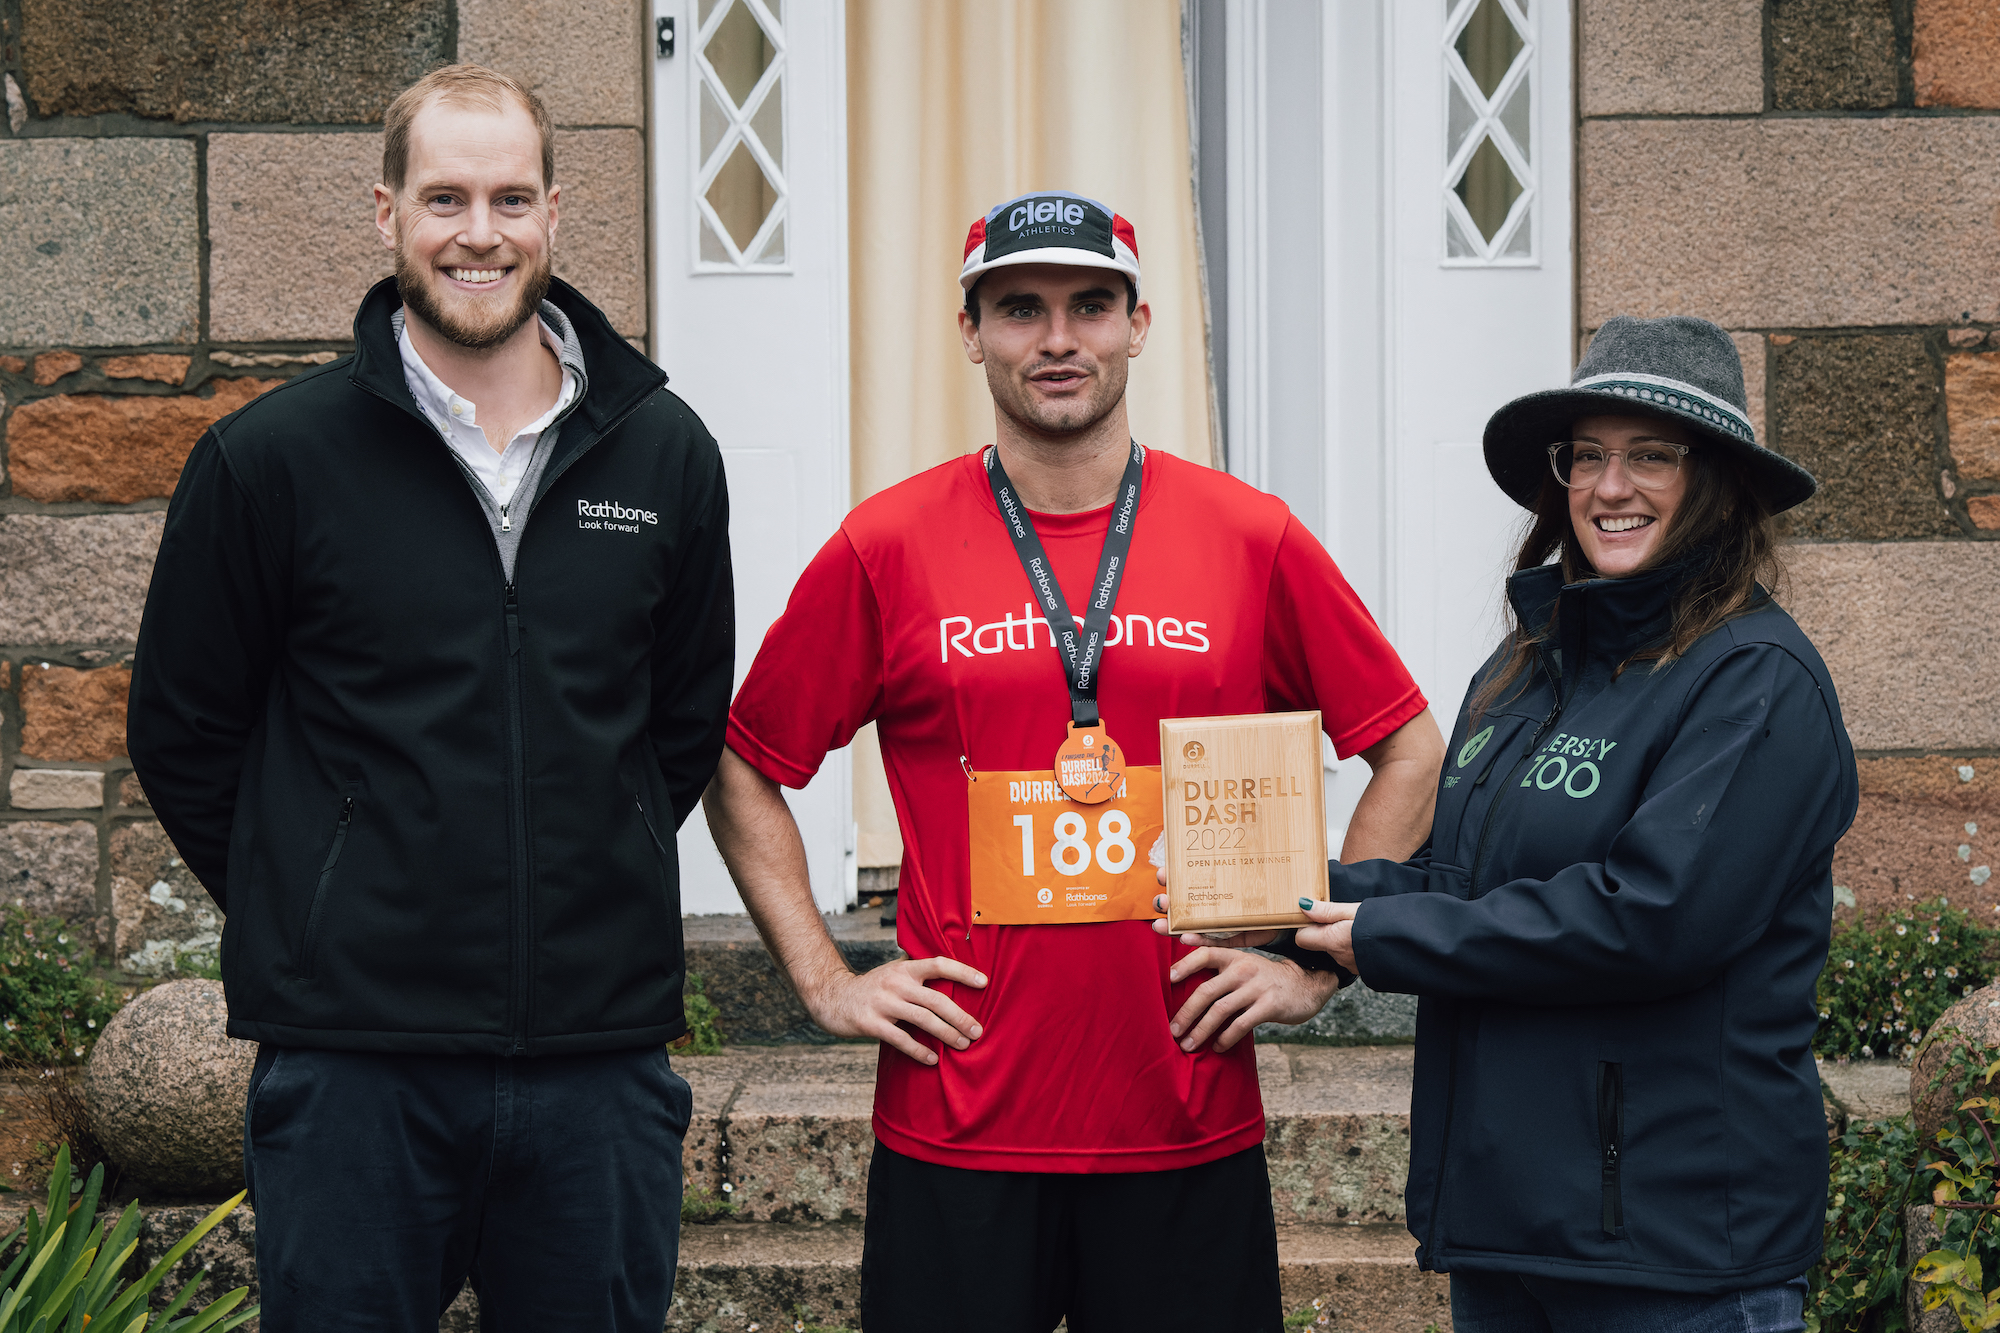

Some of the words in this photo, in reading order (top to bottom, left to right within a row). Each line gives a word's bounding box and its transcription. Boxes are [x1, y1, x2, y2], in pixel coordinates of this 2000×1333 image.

[1008, 200, 1084, 232] ciele
[1018, 225, 1076, 240] ATHLETICS
[577, 499, 659, 525] Rathbones
[999, 487, 1026, 539] Rathbones
[1115, 483, 1136, 534] Rathbones
[578, 520, 602, 530] Look
[603, 520, 639, 534] forward
[1029, 557, 1058, 611] Rathbones
[1094, 556, 1119, 609] Rathbones
[1077, 631, 1099, 690] Rathbones
[1541, 732, 1618, 761] JERSEY
[1060, 758, 1103, 774] DURRELL
[1519, 754, 1601, 799] ZOO
[1009, 781, 1071, 805] DURRE
[1184, 776, 1302, 801] DURRELL
[1184, 802, 1257, 826] DASH
[1013, 809, 1136, 876] 188
[1186, 827, 1247, 851] 2022
[1187, 859, 1211, 868] OPEN
[1213, 858, 1237, 867] MALE
[1257, 855, 1291, 864] WINNER
[1066, 893, 1107, 901] Rathbones
[1187, 891, 1234, 901] Rathbones
